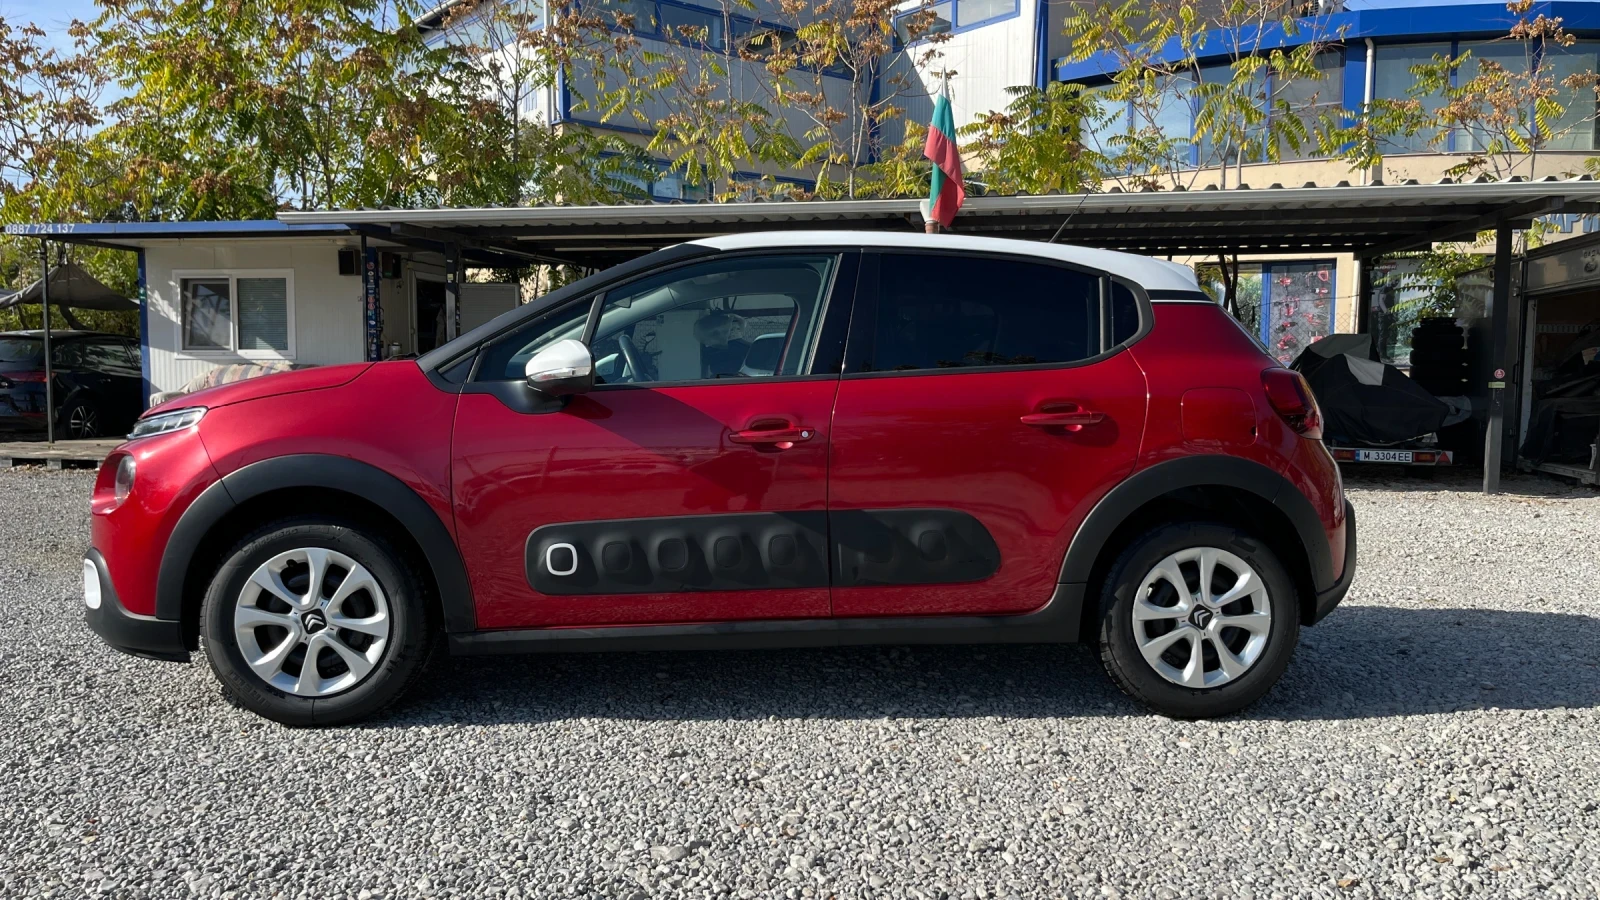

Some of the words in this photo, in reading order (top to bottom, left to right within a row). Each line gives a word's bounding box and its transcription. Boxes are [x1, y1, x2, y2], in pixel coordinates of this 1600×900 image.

[5, 224, 31, 234] 0887
[34, 224, 53, 234] 724
[57, 223, 75, 233] 137
